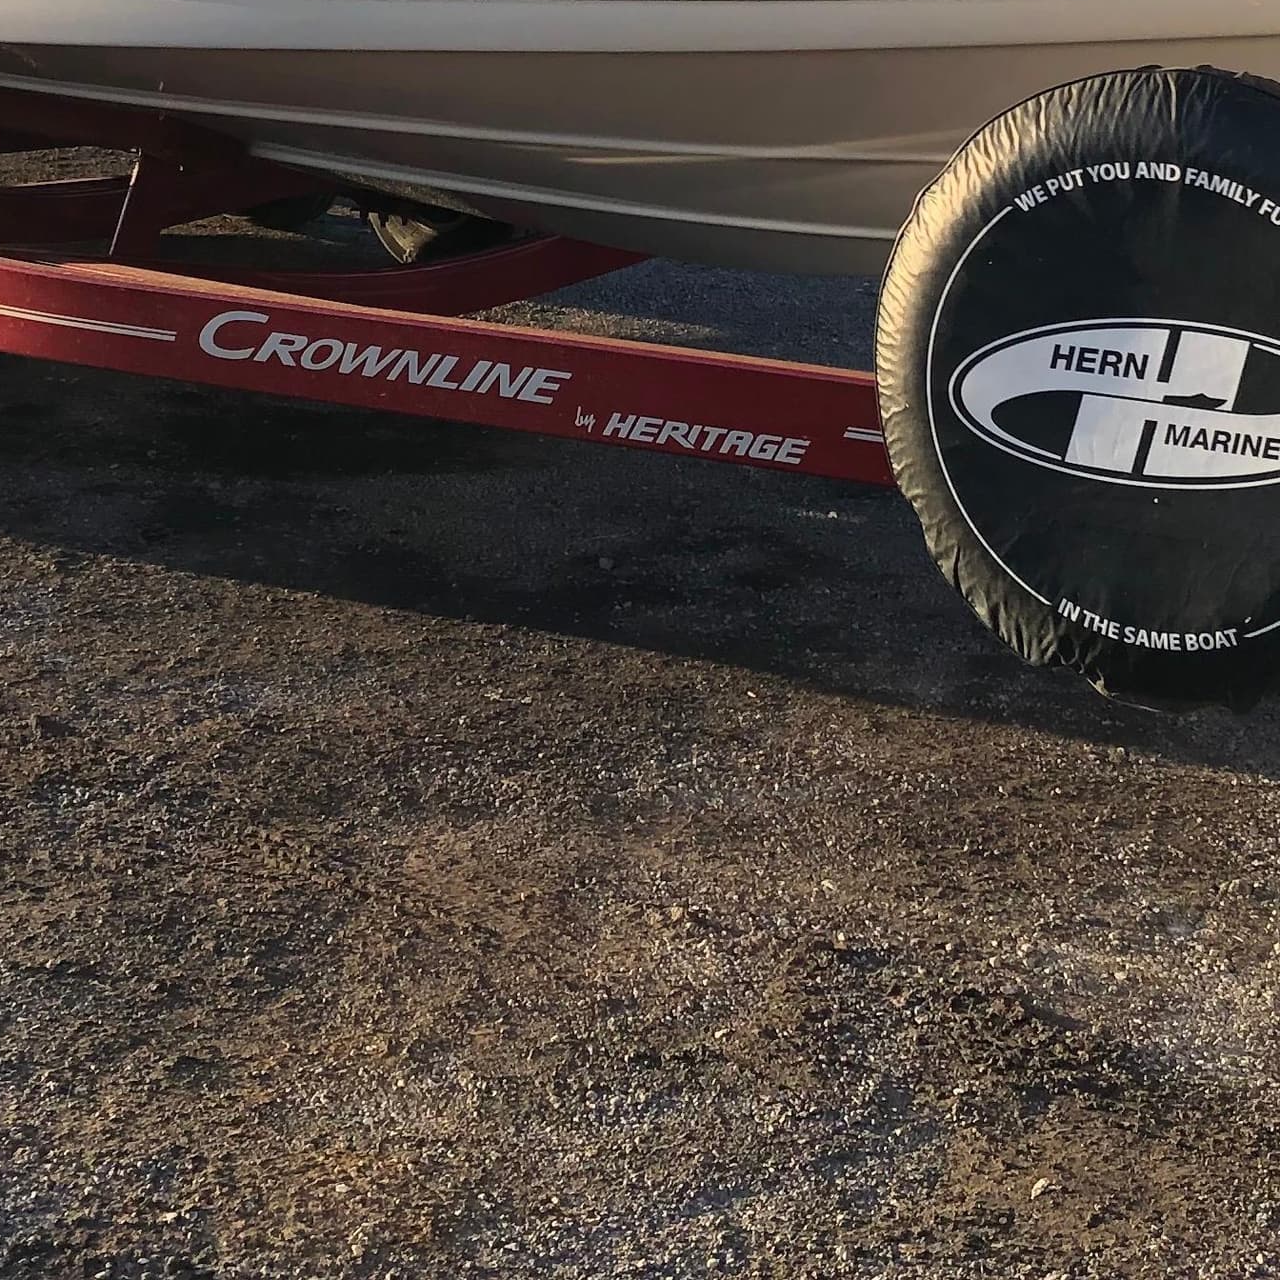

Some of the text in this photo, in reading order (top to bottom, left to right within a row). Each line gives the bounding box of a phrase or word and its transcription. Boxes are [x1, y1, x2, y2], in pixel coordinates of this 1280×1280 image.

[1013, 184, 1049, 213] WE
[1045, 169, 1084, 197] PUT
[1086, 161, 1131, 184] YOU
[1135, 161, 1182, 183] AND
[1184, 167, 1261, 208] FAMILY
[198, 310, 812, 465] CROWNLINE by HERITAGE
[1048, 343, 1150, 381] HERN
[1057, 597, 1238, 652] IN THE SAME BOAT
